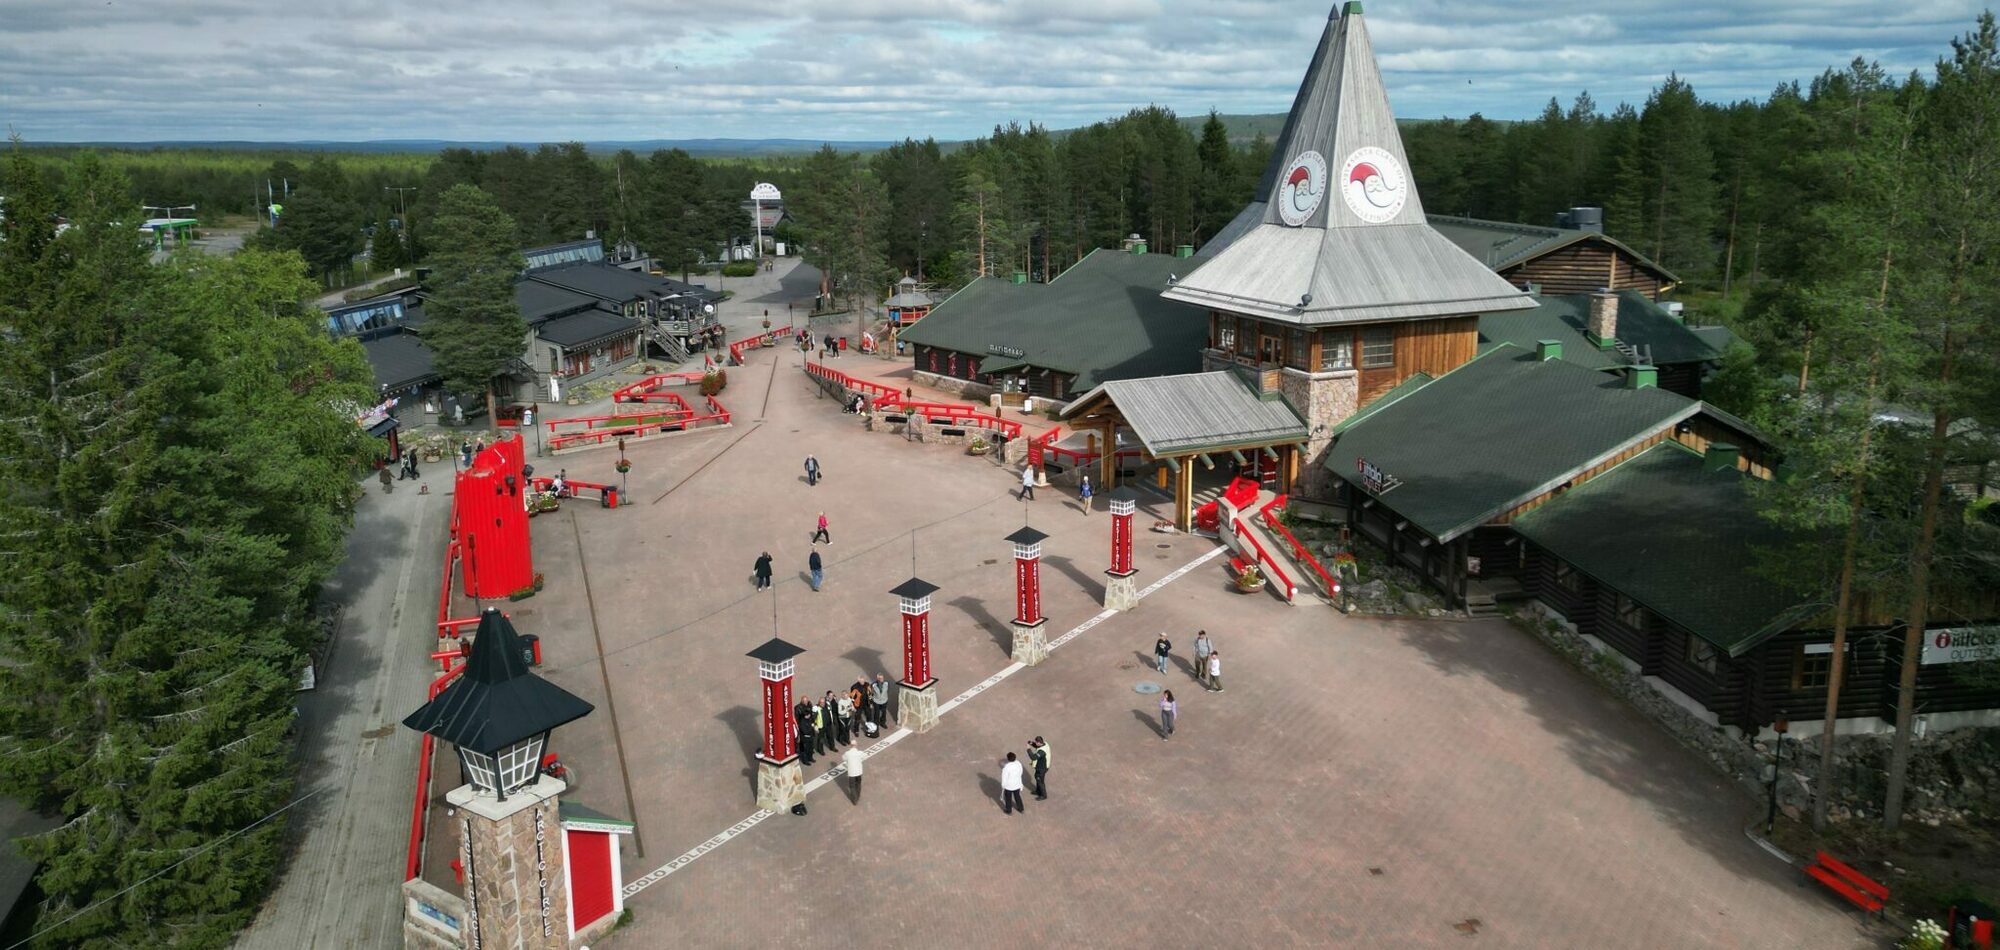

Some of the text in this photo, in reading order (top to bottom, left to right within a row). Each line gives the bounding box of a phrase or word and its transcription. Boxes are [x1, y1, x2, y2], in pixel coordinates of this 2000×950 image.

[820, 741, 890, 781] POLREIS
[462, 820, 480, 950] ARCTIC CIRCLE
[536, 809, 552, 937] ARCTIC CIRCLE
[668, 836, 726, 870] POLARE
